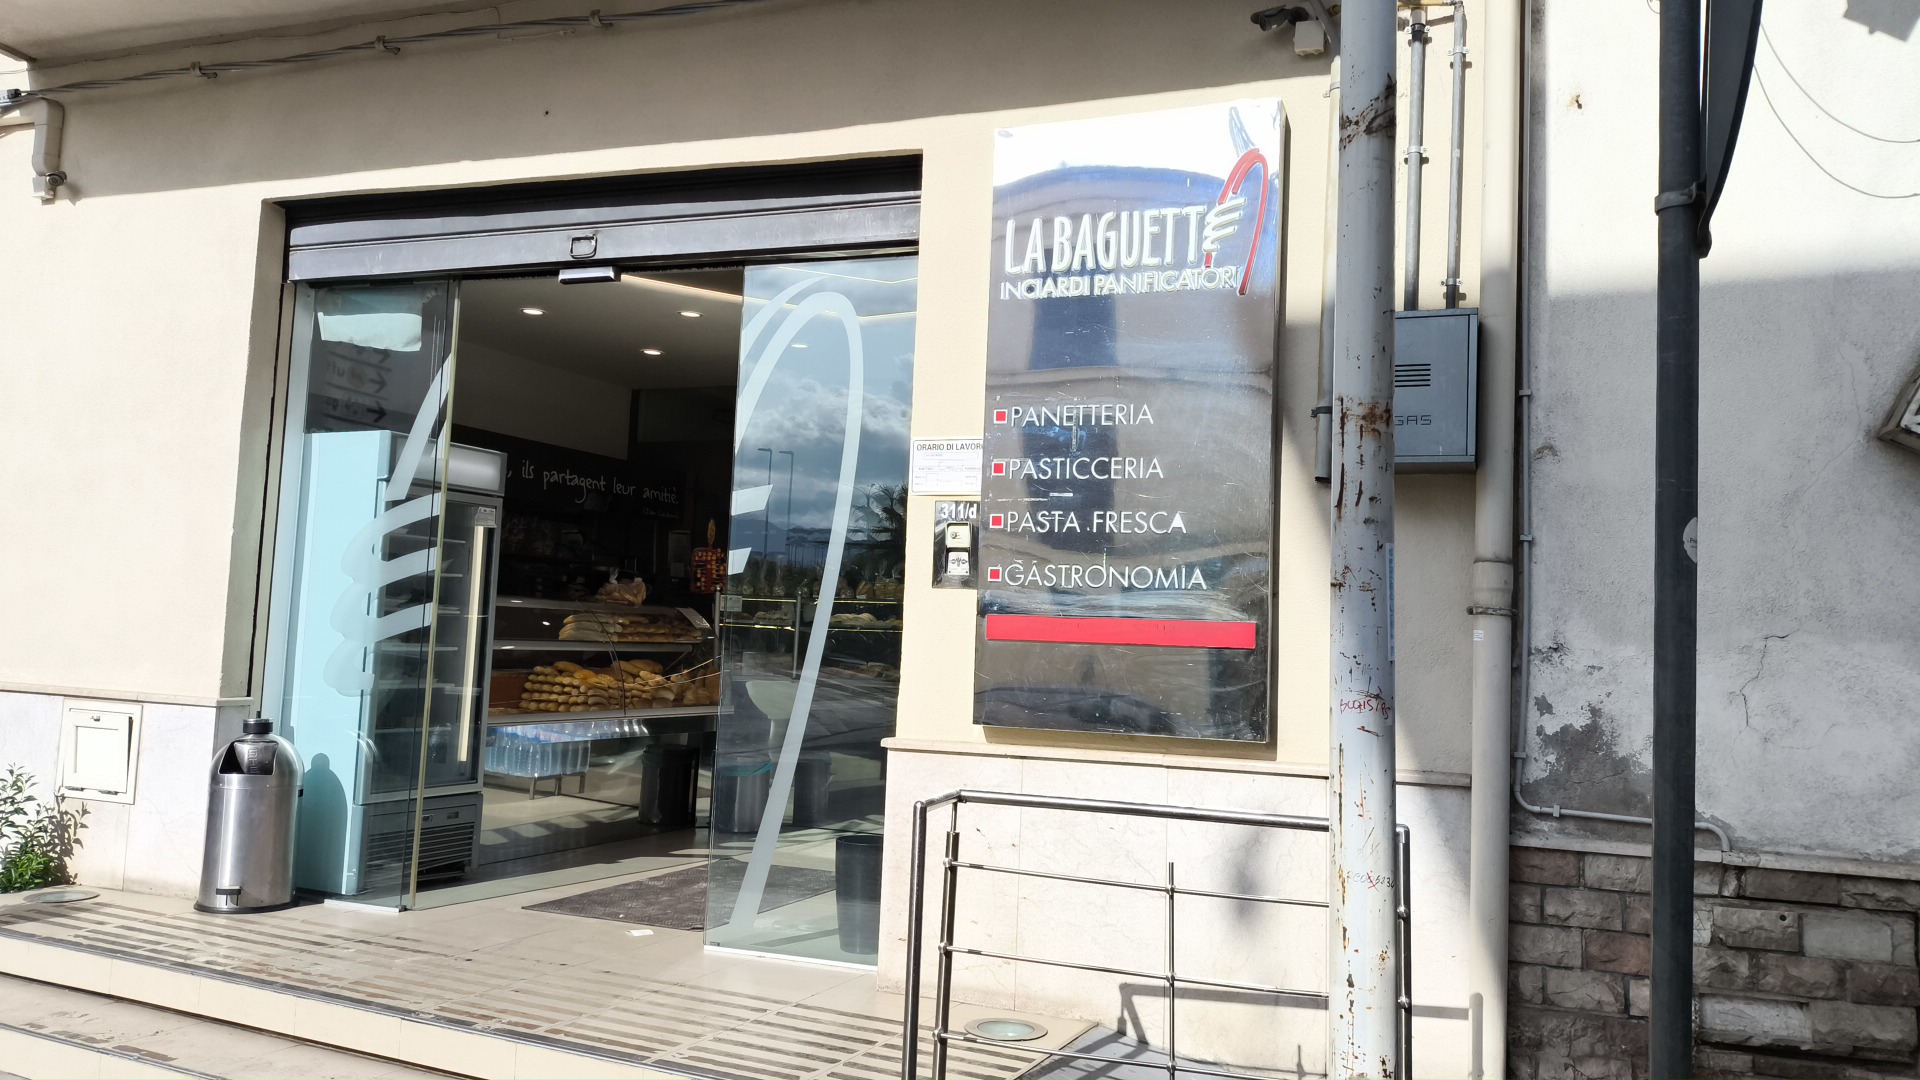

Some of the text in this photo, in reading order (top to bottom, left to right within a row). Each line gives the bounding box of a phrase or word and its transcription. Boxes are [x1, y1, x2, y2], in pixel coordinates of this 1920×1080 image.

[1004, 218, 1046, 275] LA
[1094, 265, 1240, 295] PANIFICATORI
[1010, 403, 1154, 427] PANETTERIA
[1394, 415, 1432, 426] GAS
[916, 443, 983, 451] ORARIO DI LAVOR
[1008, 457, 1164, 480] PASTICCERIA
[521, 460, 535, 479] ils
[543, 469, 606, 504] partagent
[613, 477, 637, 496] leur
[941, 503, 978, 519] 311/d
[1006, 510, 1187, 535] PASTA FRESCA
[1004, 564, 1207, 590] GASTRONOMIA
